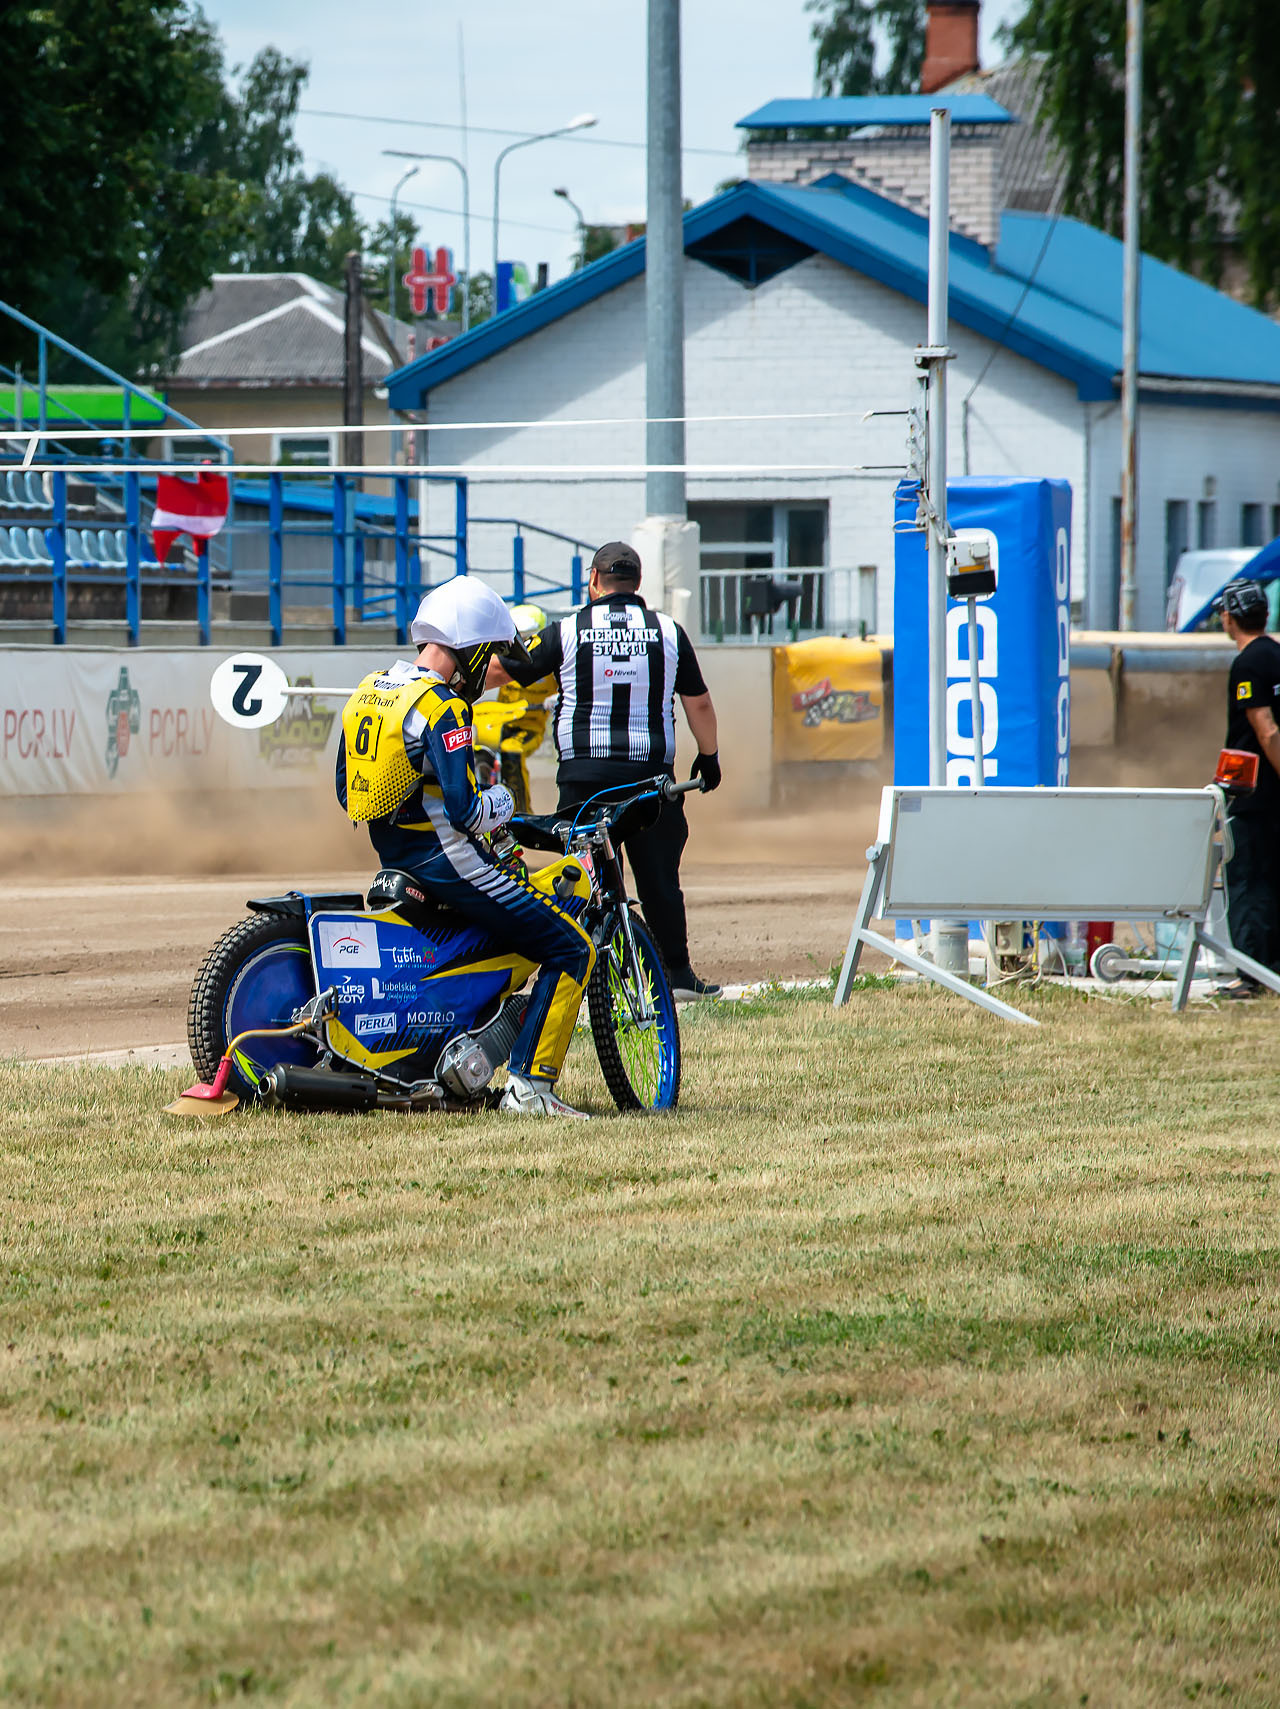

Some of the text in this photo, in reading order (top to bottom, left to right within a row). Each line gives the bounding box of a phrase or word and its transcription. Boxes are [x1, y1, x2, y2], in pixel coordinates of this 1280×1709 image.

[580, 628, 659, 643] KIEROWNIK
[593, 642, 648, 656] STARTU
[232, 664, 262, 716] 2
[3, 708, 76, 760] PCR.LV
[355, 715, 373, 755] 6
[339, 945, 359, 954] PGE
[382, 981, 417, 992] lubelskie
[407, 1011, 455, 1024] MOTRIO
